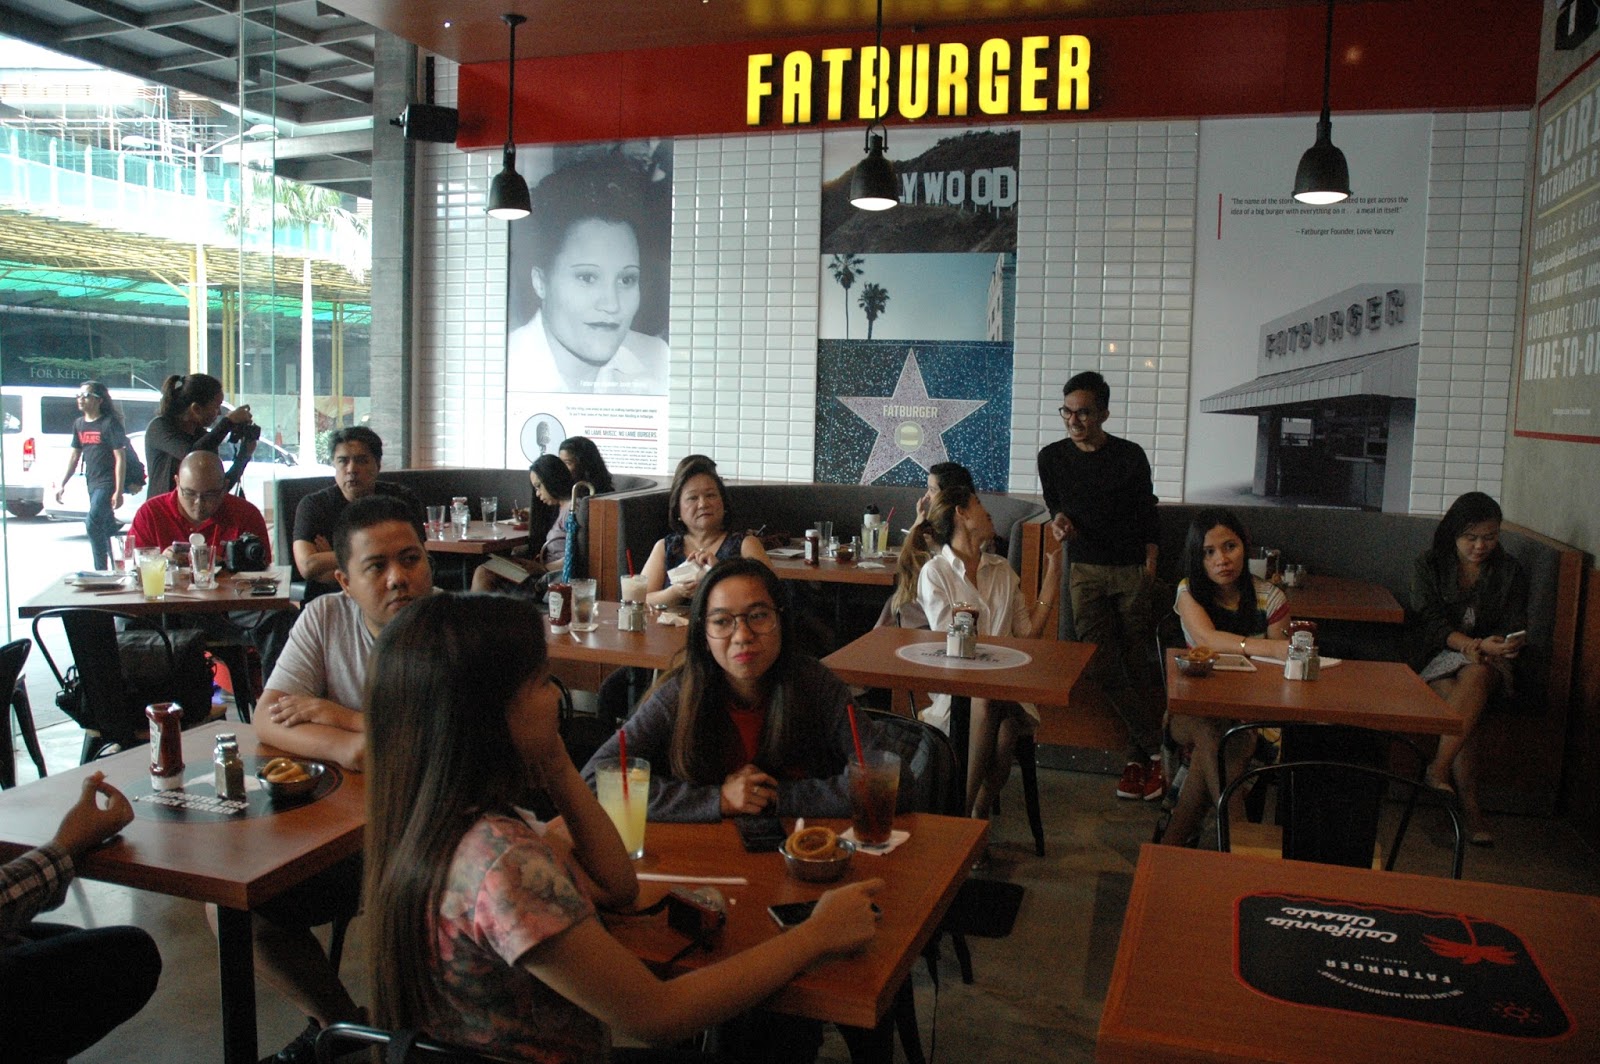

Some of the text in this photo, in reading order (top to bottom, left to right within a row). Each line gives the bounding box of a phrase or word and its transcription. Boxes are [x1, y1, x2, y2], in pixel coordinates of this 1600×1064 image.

[747, 34, 1091, 125] FATBURGER
[898, 166, 1016, 207] YWOOD
[1538, 155, 1588, 208] FATBURGER
[1256, 208, 1264, 216] big
[1266, 208, 1285, 216] burger
[1300, 207, 1332, 216] everything
[1301, 228, 1330, 236] Fatburger
[1374, 228, 1394, 236] Yancey
[1265, 288, 1406, 359] FATBURGER
[1527, 305, 1571, 341] HOMEMADE
[30, 367, 52, 379] FOR
[882, 404, 938, 419] FATBURGER
[1265, 915, 1398, 943] California
[1281, 906, 1376, 928] Classic
[1325, 959, 1451, 984] FATBURGER
[1346, 982, 1402, 998] HAMBURGER
